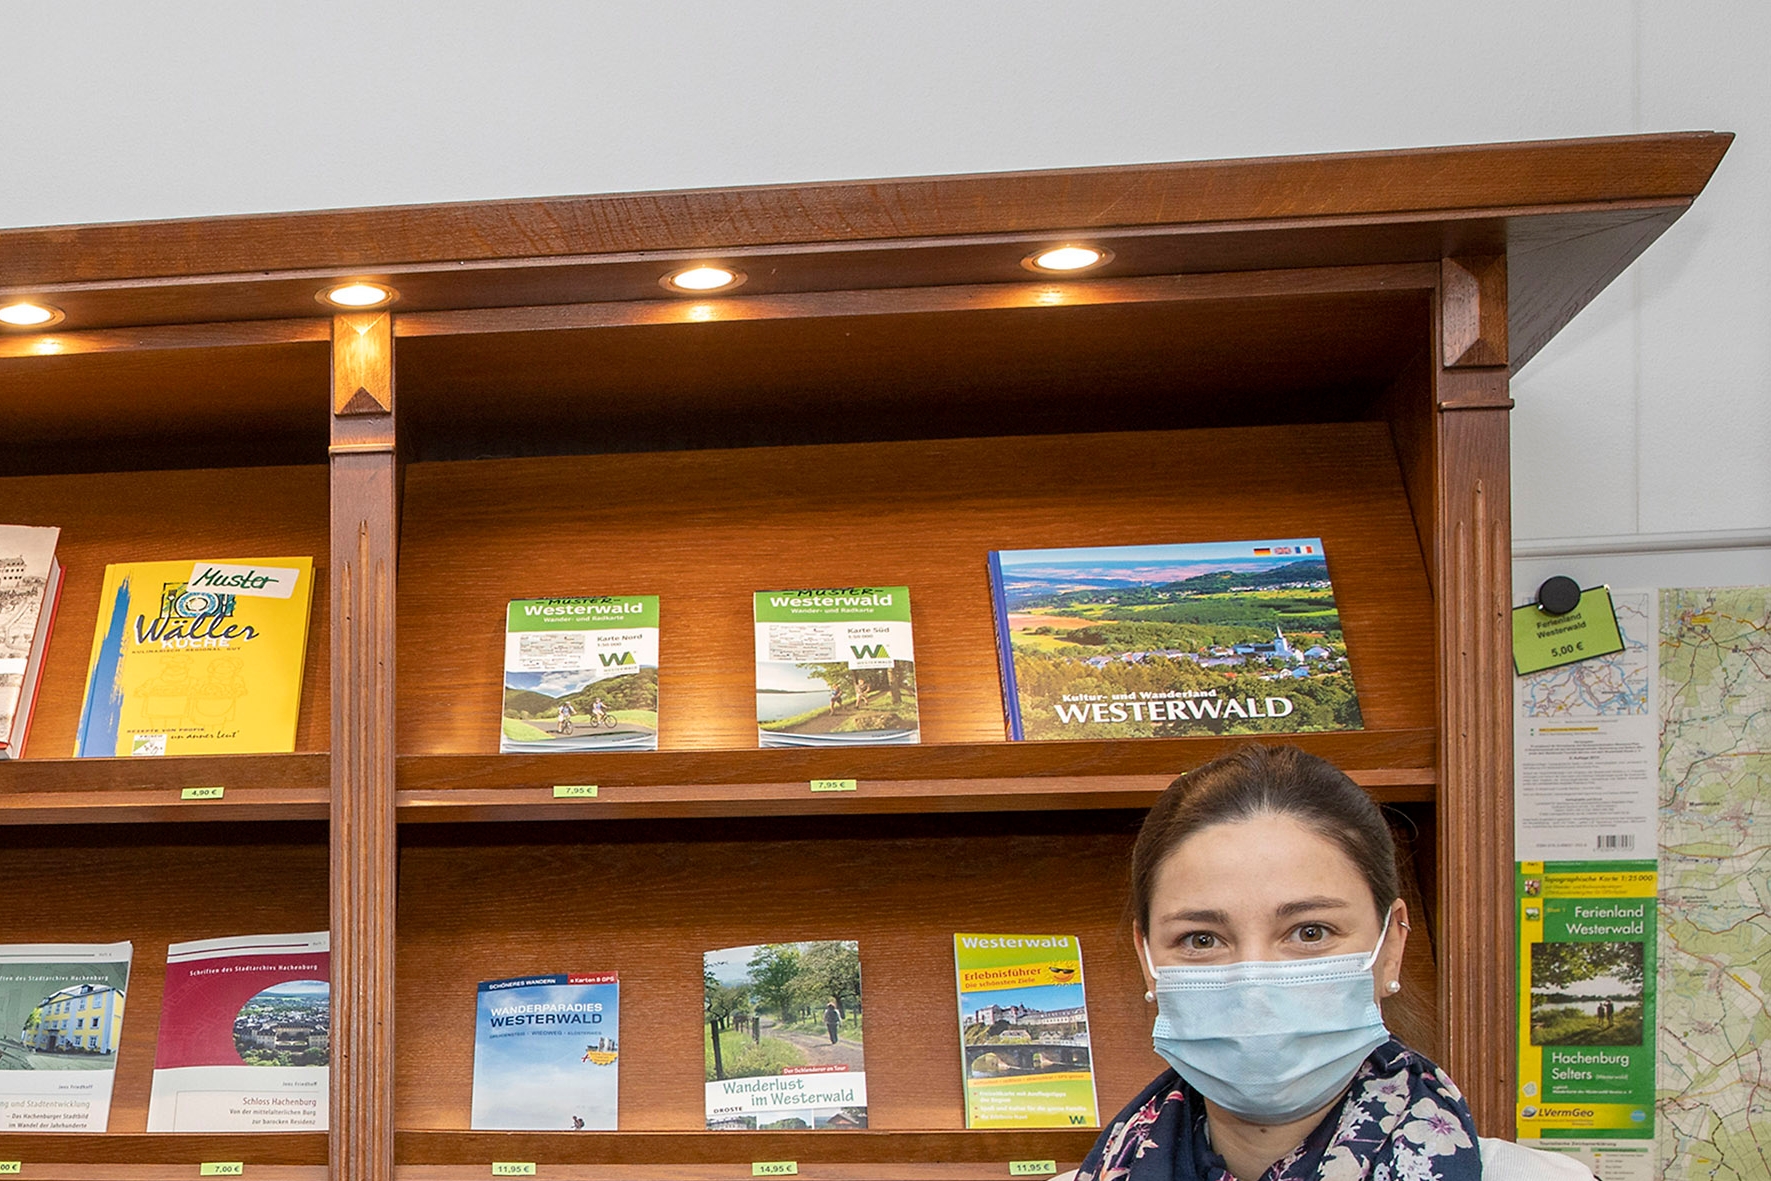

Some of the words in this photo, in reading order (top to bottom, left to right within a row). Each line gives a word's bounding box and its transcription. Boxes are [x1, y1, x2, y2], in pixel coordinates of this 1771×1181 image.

[192, 568, 279, 589] Muster
[770, 594, 893, 607] Westerwald
[524, 603, 643, 616] Westerwald
[1536, 612, 1582, 629] Ferienland
[135, 613, 259, 645] Wäller
[1537, 621, 1586, 639] Westerwald
[622, 633, 643, 641] Nord
[1550, 644, 1574, 658] 5,00
[1576, 641, 1584, 651] €
[1062, 692, 1108, 702] Kultur-
[1112, 692, 1136, 701] und
[1139, 688, 1217, 700] Wanderland
[1054, 697, 1294, 724] WESTERWALD
[1574, 904, 1644, 919] Ferienland
[1566, 921, 1644, 935] Westerwald
[961, 937, 1069, 949] Westerwald
[189, 967, 220, 977] Schriften
[235, 964, 276, 972] Stadtarchivs
[278, 964, 319, 973] Hachenburg
[964, 967, 1041, 982] Erlebnisführer
[70, 975, 109, 983] Hachenburg
[490, 1003, 604, 1017] WANDERPARADIES
[490, 1013, 603, 1028] WESTERWALD
[1552, 1051, 1630, 1068] Hachenburg
[1552, 1067, 1593, 1080] Selters
[722, 1077, 805, 1094] Wanderlust
[10, 1100, 22, 1108] und
[26, 1099, 91, 1109] Stadtentwicklung
[242, 1097, 270, 1106] Schloss
[271, 1098, 317, 1107] Hachenburg
[751, 1093, 768, 1106] im
[769, 1089, 855, 1105] Westerwald
[1538, 1108, 1595, 1118] LVermGeo
[11, 1163, 17, 1171] €
[214, 1165, 233, 1173] 7,00
[233, 1165, 240, 1173] €
[523, 1165, 530, 1173] €
[760, 1165, 785, 1173] 14,95
[786, 1164, 793, 1172] €
[1043, 1163, 1050, 1171] €
